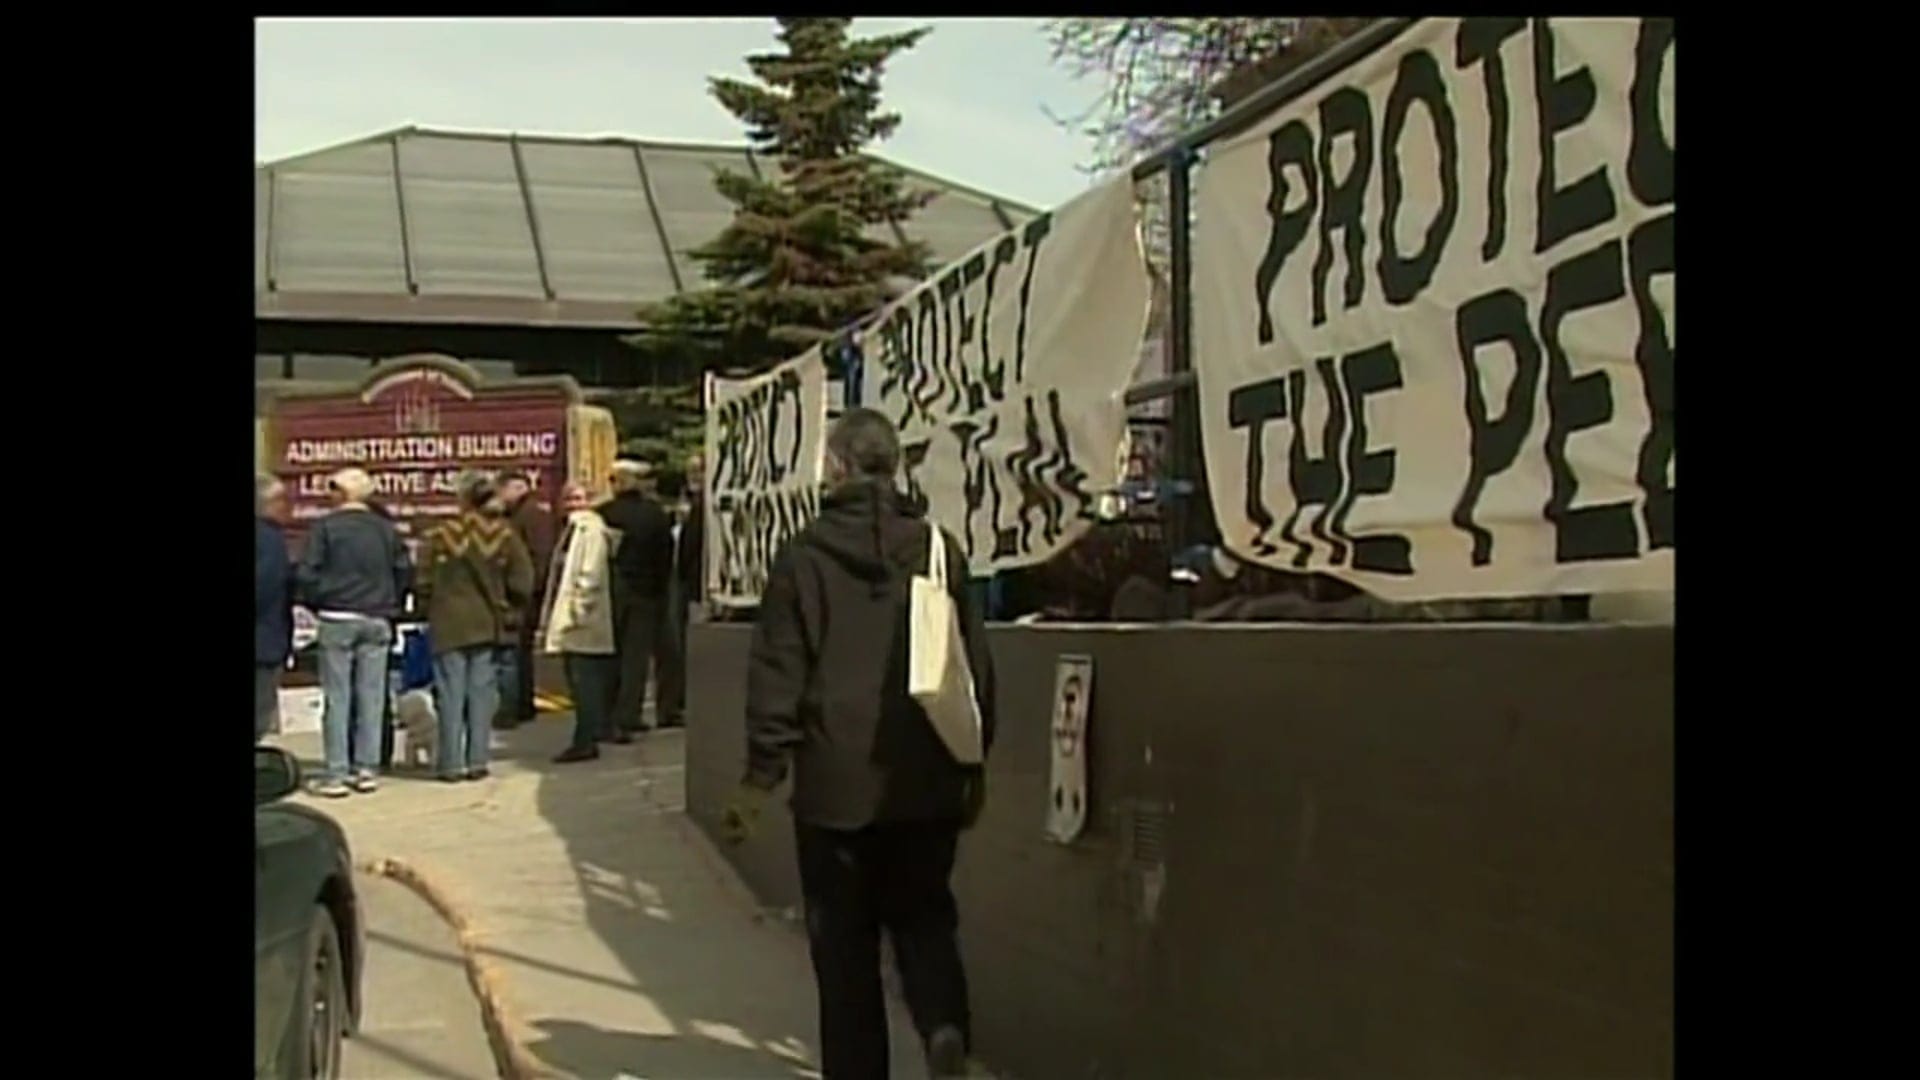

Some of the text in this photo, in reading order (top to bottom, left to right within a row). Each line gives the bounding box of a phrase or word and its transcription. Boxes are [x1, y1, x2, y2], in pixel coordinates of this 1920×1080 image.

[880, 212, 1053, 431] PROTECT
[286, 433, 556, 462] ADMINISTRATION BUILDING
[300, 471, 425, 495] LEATIVE
[713, 367, 801, 493] PROTECT
[1229, 341, 1413, 573] THE
